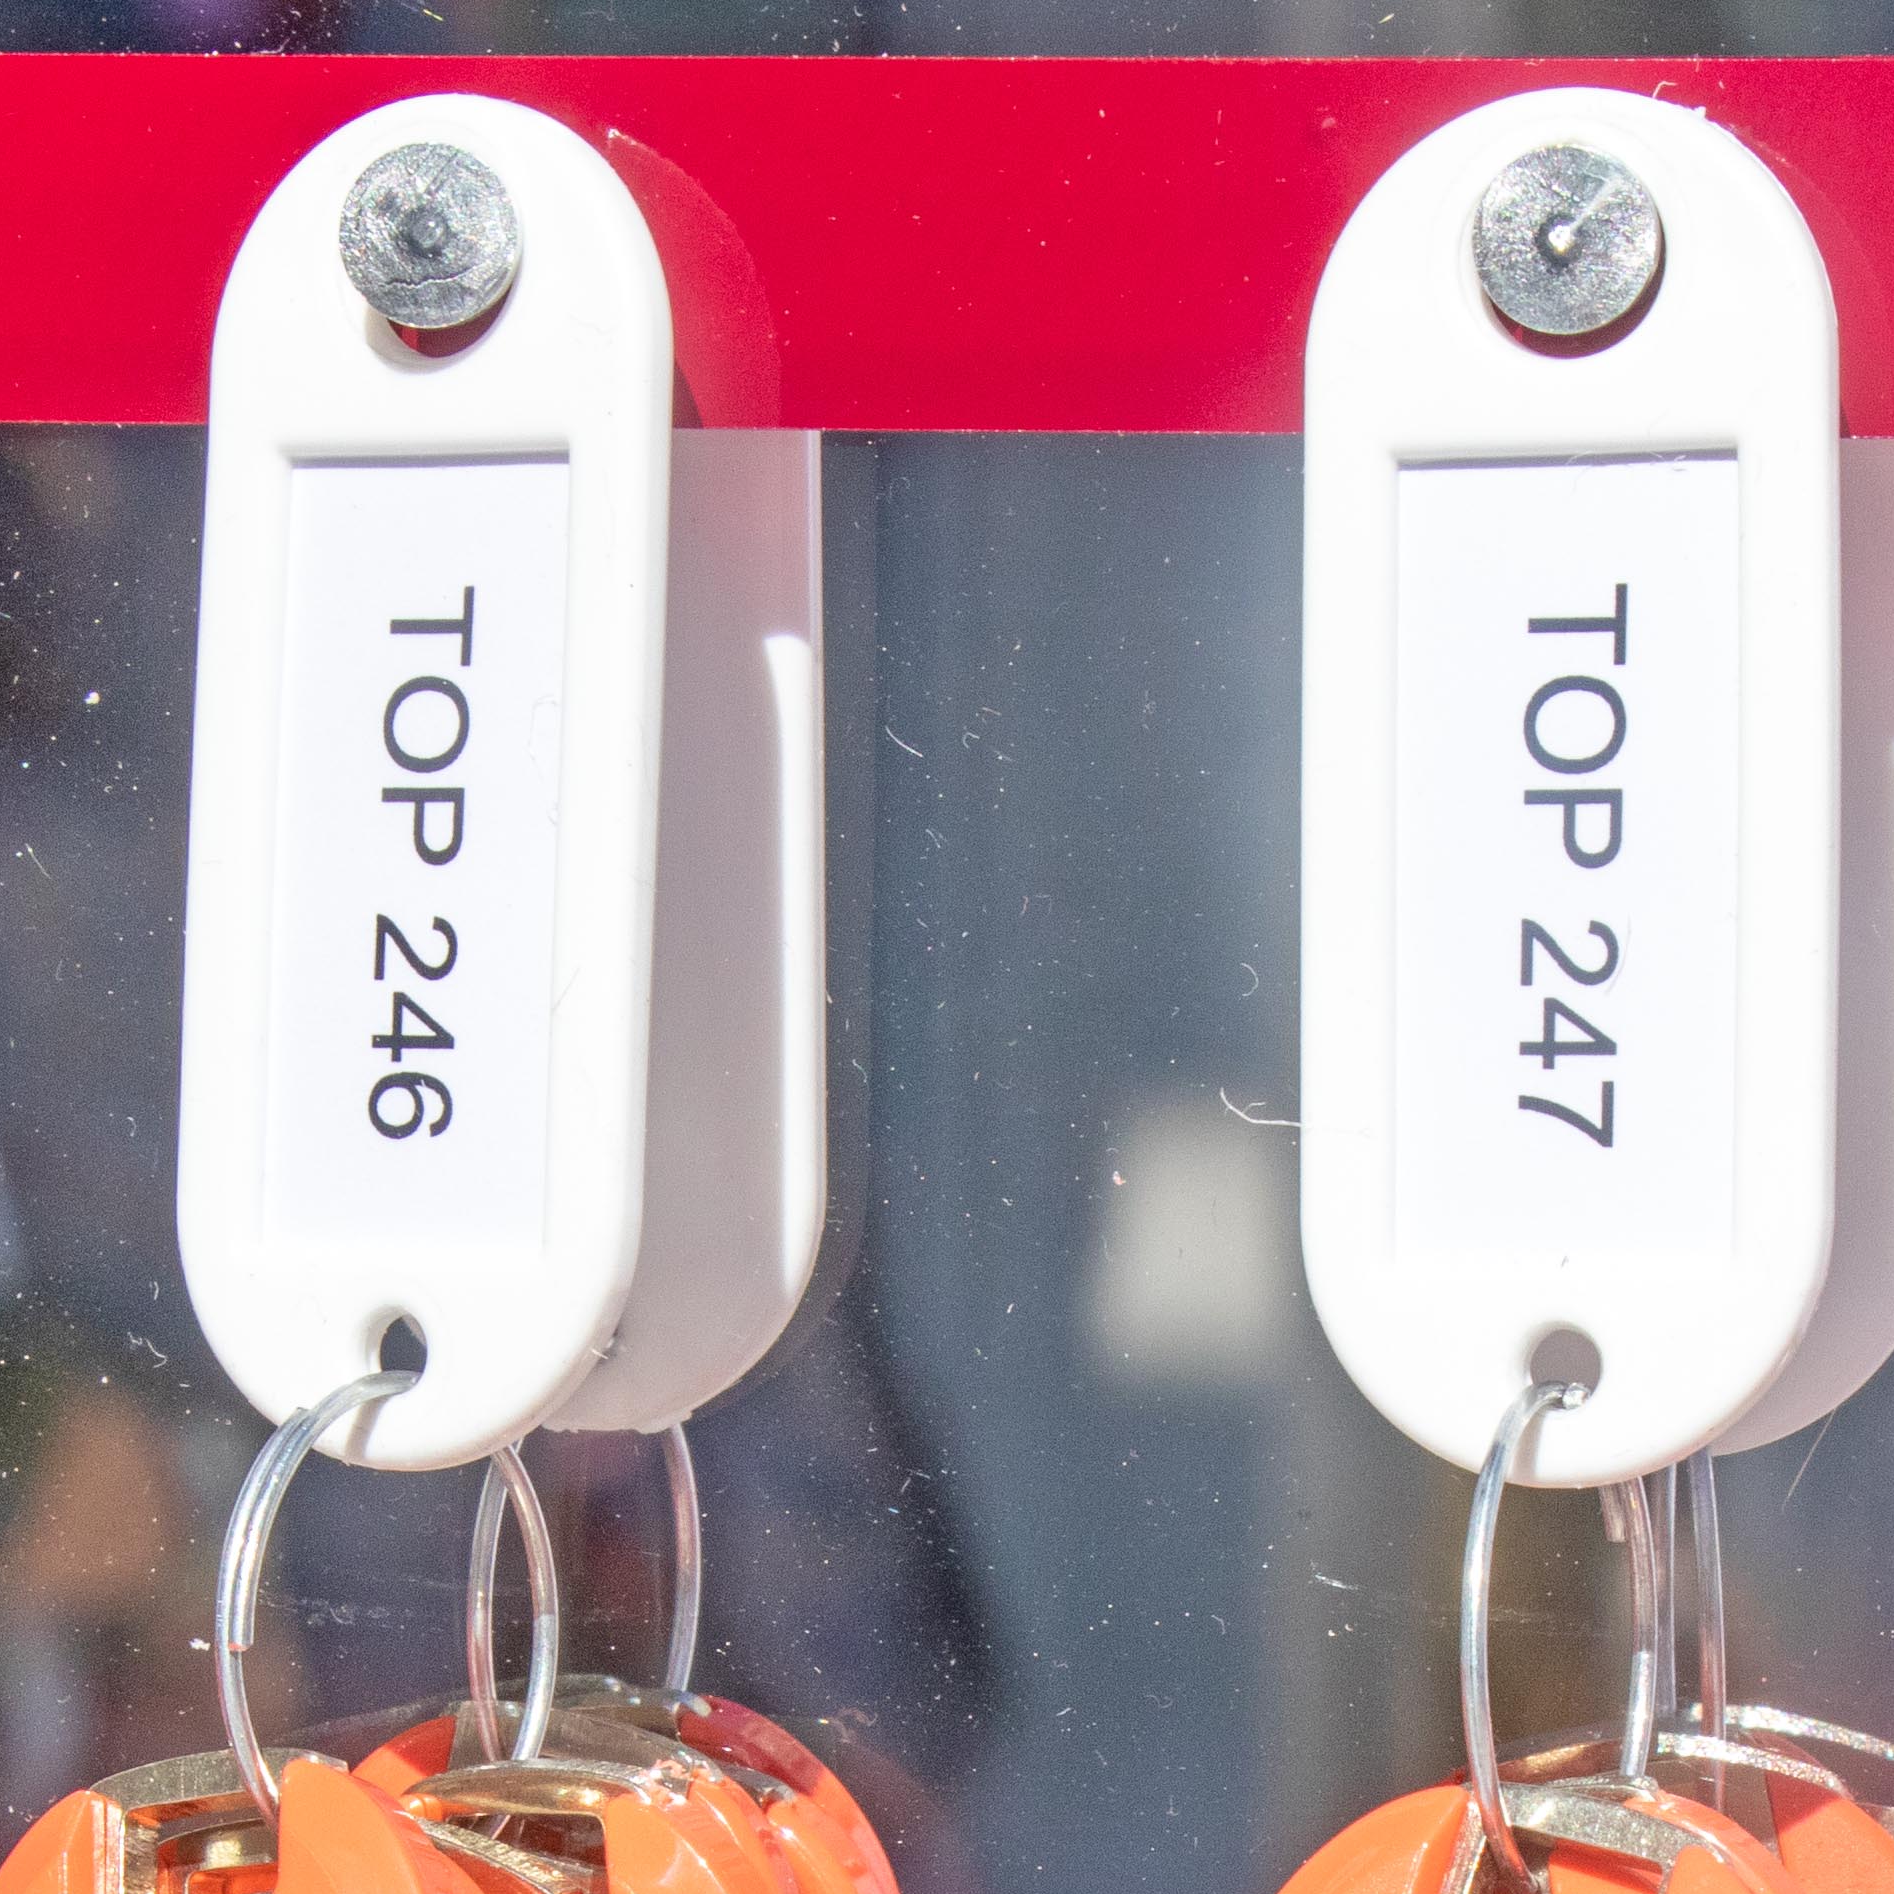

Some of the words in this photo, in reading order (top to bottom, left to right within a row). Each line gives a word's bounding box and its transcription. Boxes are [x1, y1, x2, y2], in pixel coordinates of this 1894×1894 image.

[381, 585, 475, 867] TOP
[1522, 582, 1629, 870] TOP
[367, 913, 459, 1140] 246
[1517, 917, 1620, 1148] 247
